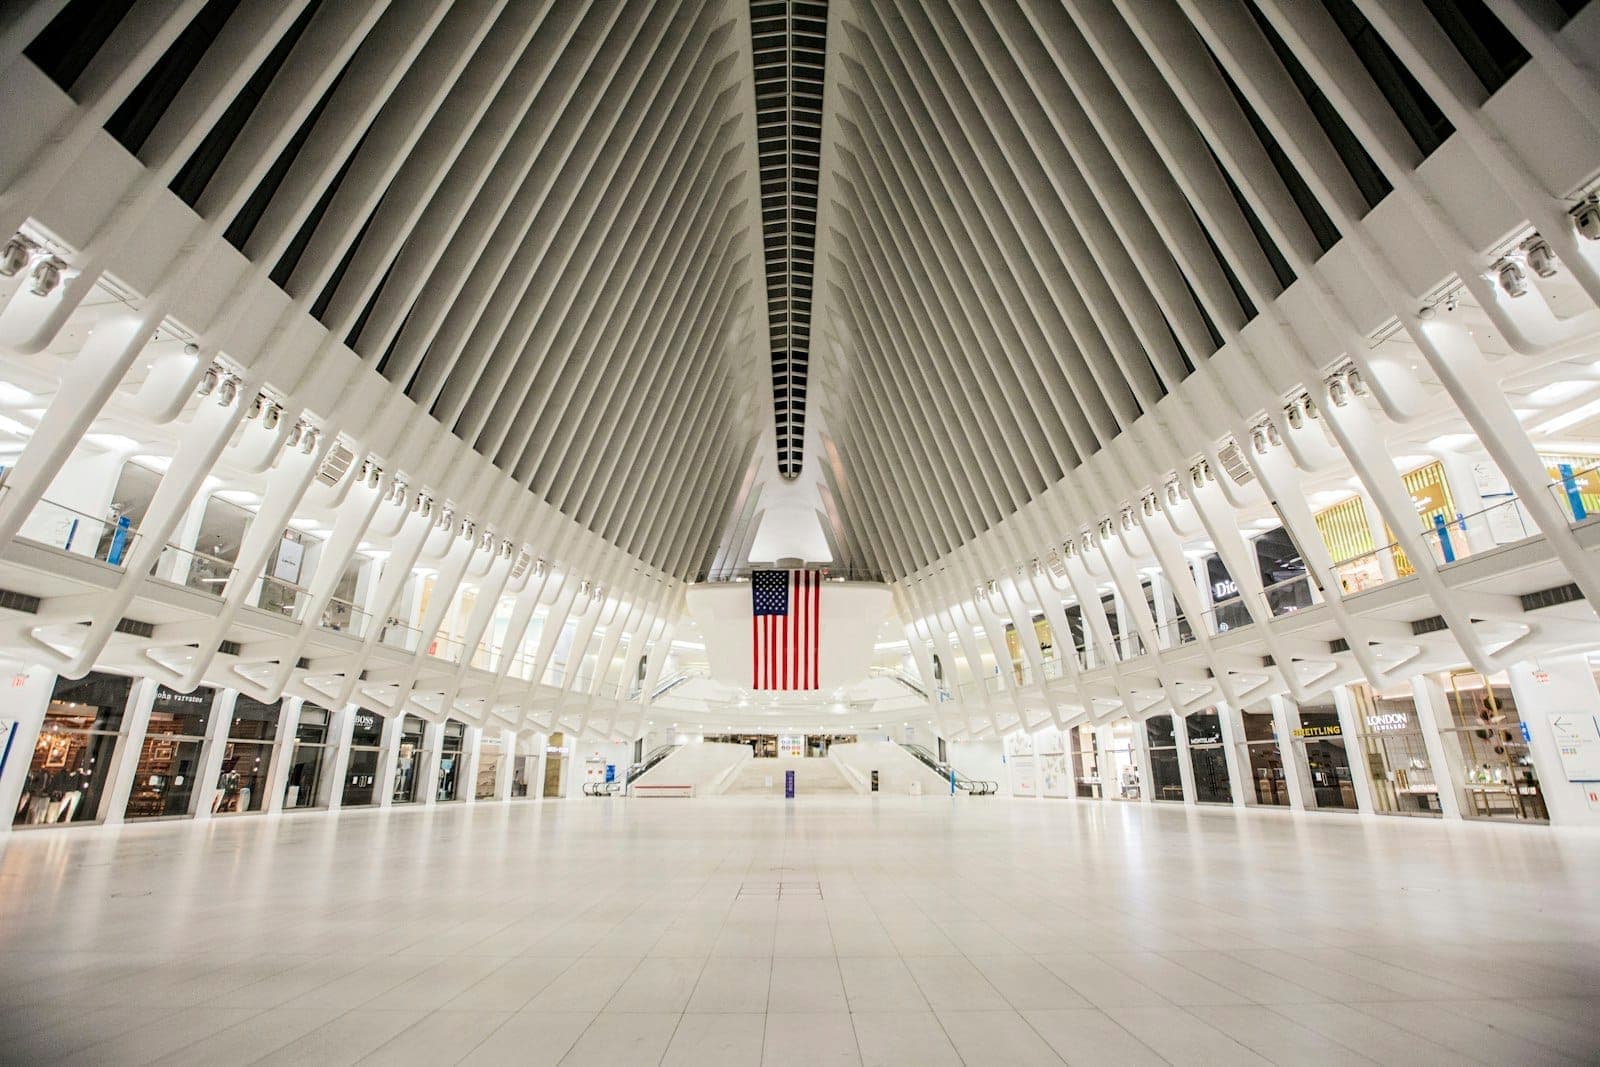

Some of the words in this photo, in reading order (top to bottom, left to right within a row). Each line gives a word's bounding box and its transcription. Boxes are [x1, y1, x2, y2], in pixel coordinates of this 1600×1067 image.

[1215, 580, 1238, 598] Dio
[156, 691, 171, 699] ohn
[1366, 713, 1408, 726] LONDON
[1293, 726, 1341, 736] BREITLING
